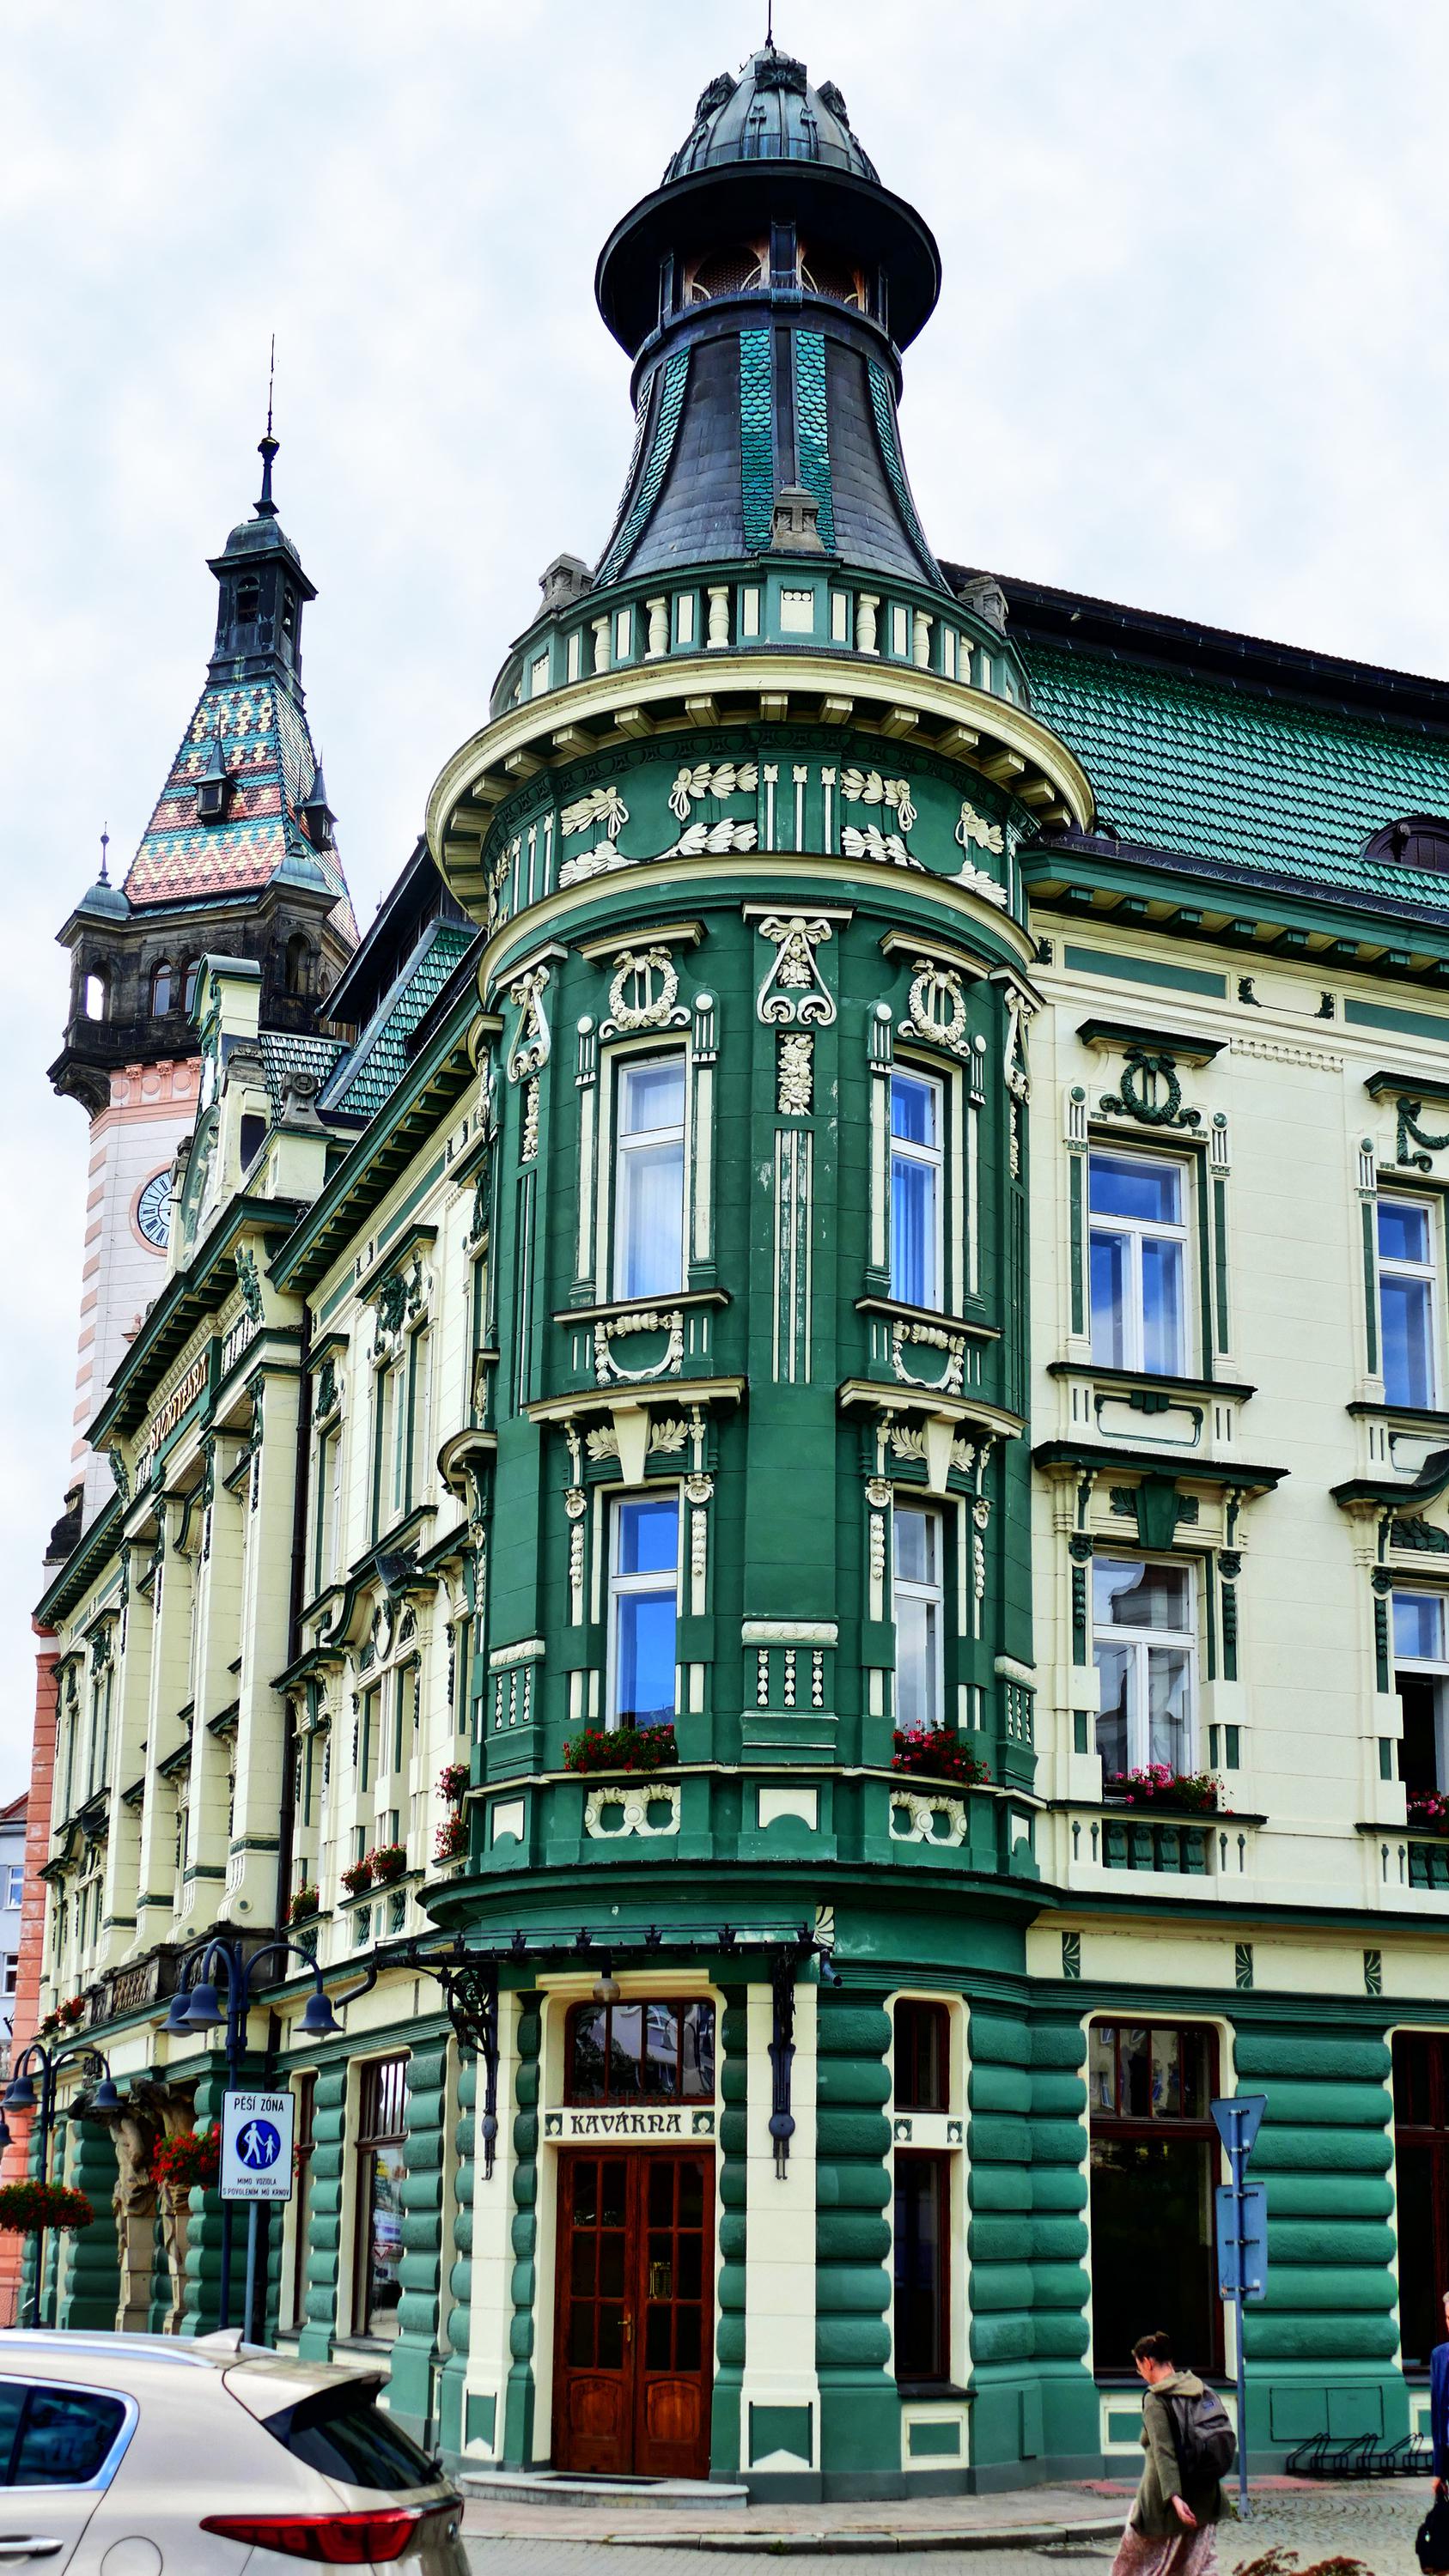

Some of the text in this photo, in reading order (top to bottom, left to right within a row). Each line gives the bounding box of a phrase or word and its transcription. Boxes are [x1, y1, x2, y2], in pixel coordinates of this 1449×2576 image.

[234, 2096, 284, 2111] PĚŠÍ ZÓNA
[570, 2111, 681, 2135] KAVÁRNA
[228, 2187, 259, 2196] POVOLENÍM
